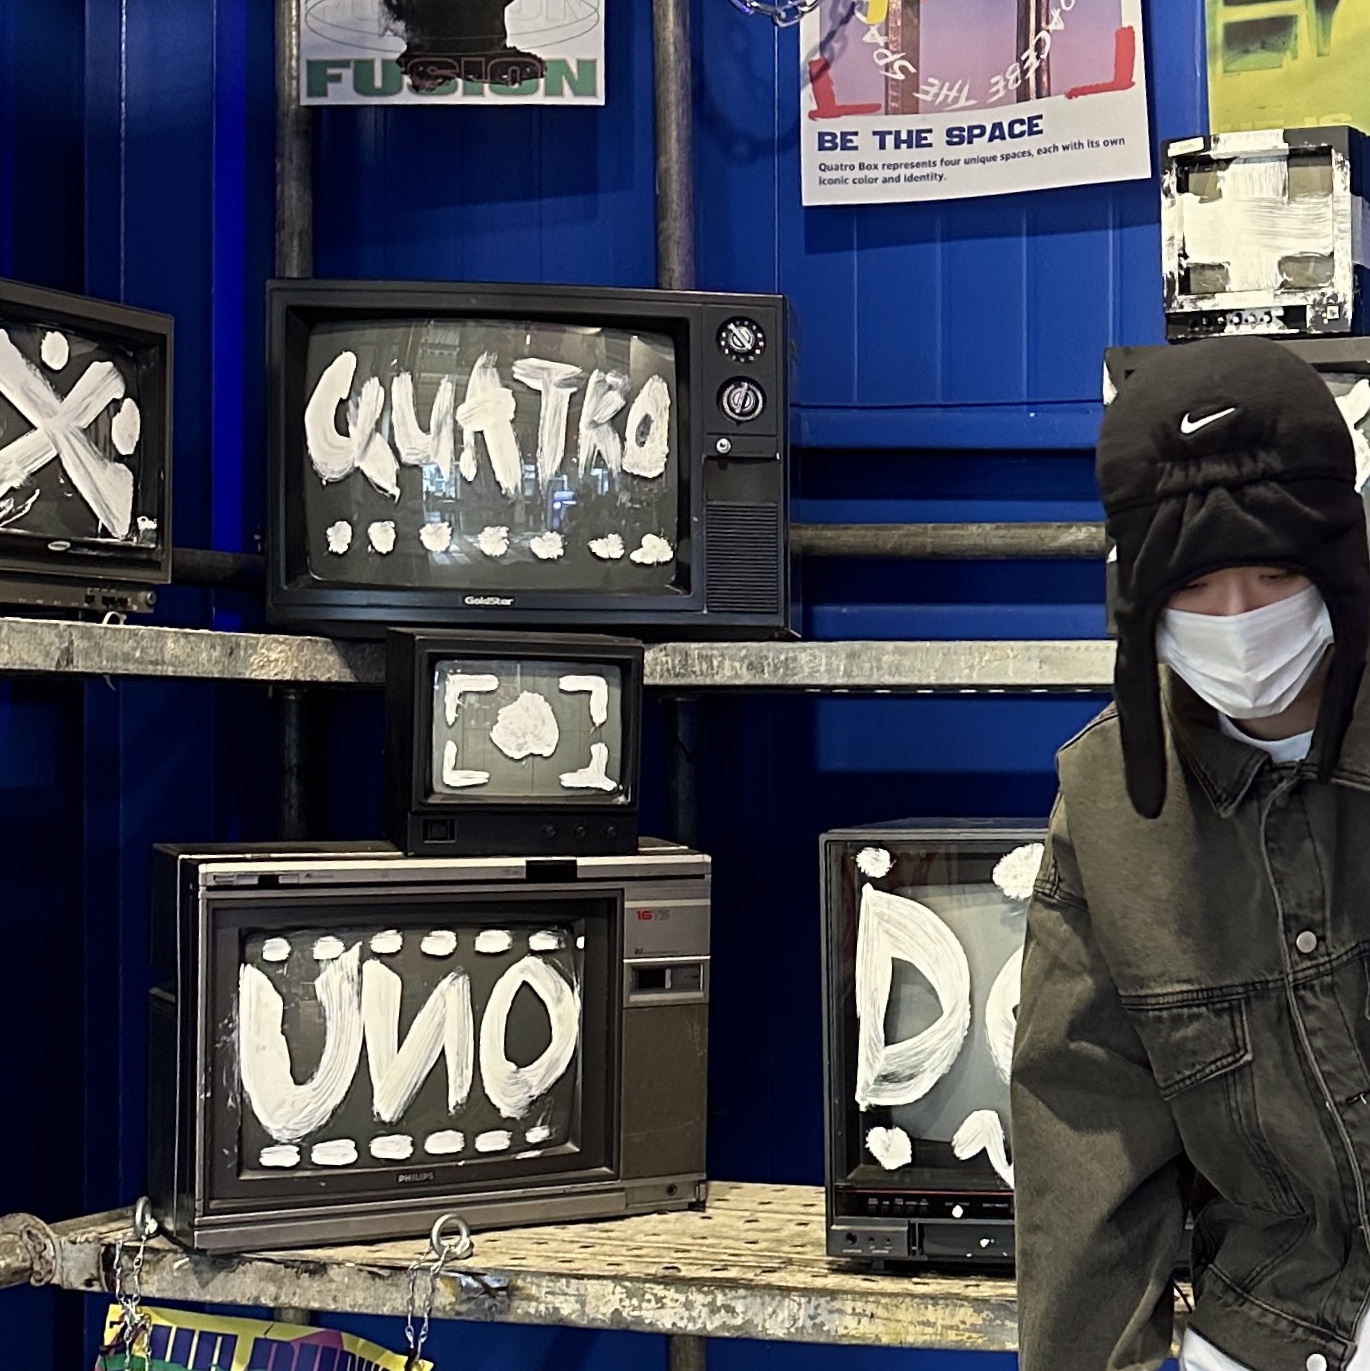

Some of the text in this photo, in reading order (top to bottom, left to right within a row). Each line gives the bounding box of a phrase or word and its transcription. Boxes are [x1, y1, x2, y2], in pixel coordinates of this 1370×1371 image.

[306, 57, 598, 98] FUSION
[913, 77, 978, 110] THE
[817, 114, 1044, 151] BE THE SPACE
[818, 137, 1126, 172] Quatro Box represents four unique spaces, each with its own
[818, 175, 849, 186] iconic
[852, 174, 879, 185] color
[881, 174, 901, 184] and
[304, 350, 671, 502] QUATRO
[464, 596, 514, 605] GoldStar
[239, 941, 581, 1142] UNO
[398, 1171, 434, 1182] PHILIPS
